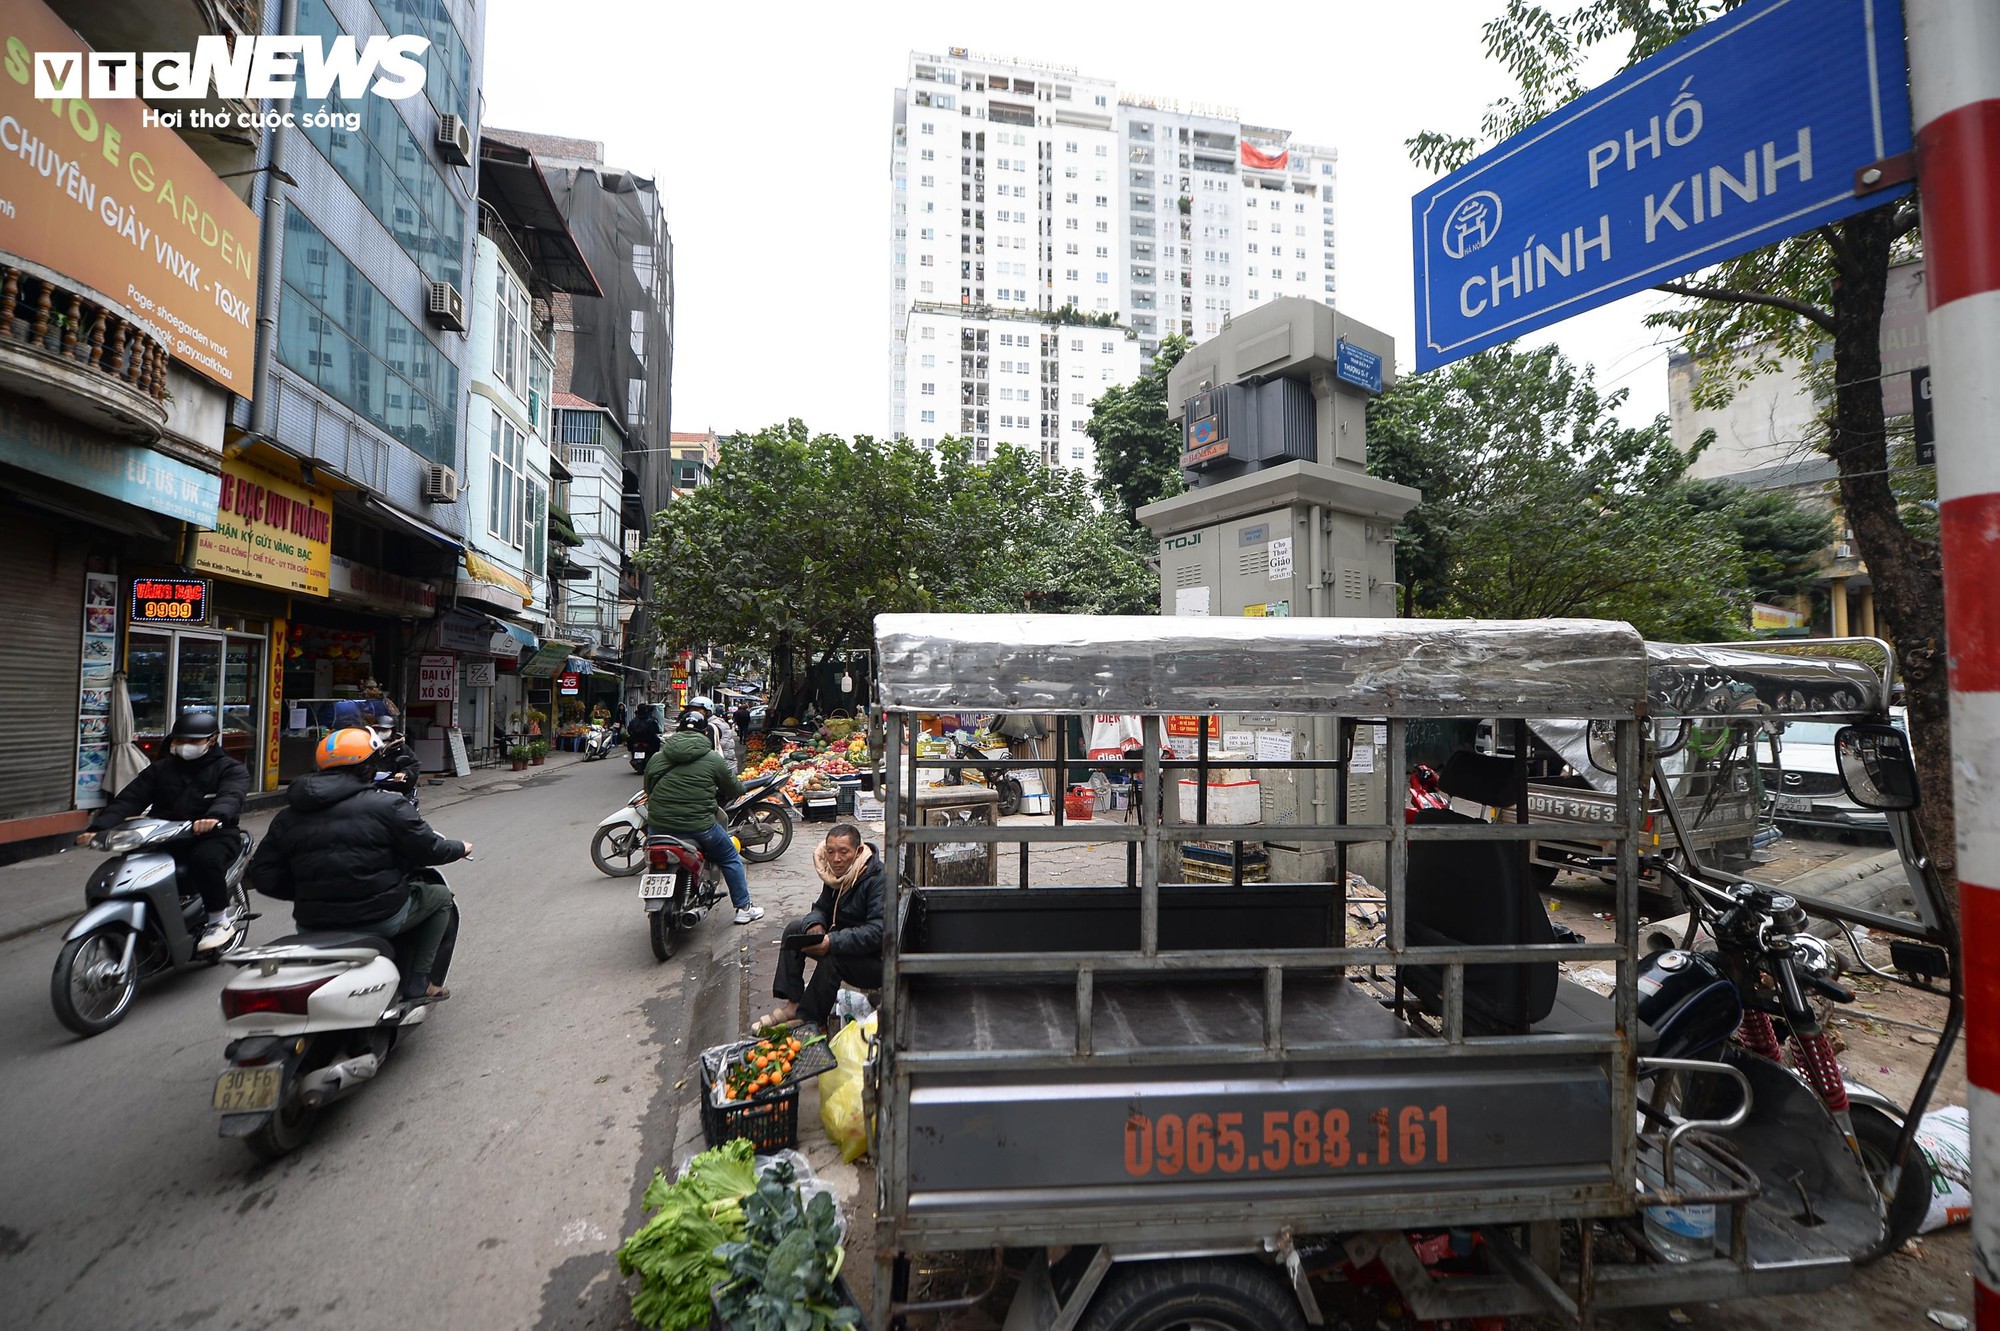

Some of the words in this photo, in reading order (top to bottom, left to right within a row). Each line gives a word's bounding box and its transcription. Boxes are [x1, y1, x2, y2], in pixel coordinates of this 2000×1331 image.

[1589, 75, 1704, 189] PHỐ
[0, 115, 96, 212] CHUYÊN
[100, 195, 150, 251] GIÀY
[155, 234, 201, 292] VNXK
[214, 280, 251, 329] TQXK
[129, 152, 252, 280] GARDEN
[1460, 214, 1611, 318] CHÍNH
[1645, 126, 1814, 244] KINH
[127, 284, 156, 313] Page:
[157, 306, 209, 346] shoegarden
[209, 339, 228, 359] vnxk
[235, 478, 265, 527] BẠC
[265, 489, 292, 532] DUY
[274, 537, 295, 556] VÀNG
[297, 547, 313, 561] BẠC
[1164, 533, 1202, 550] TOJI
[1269, 556, 1291, 568] Giáo
[136, 579, 172, 599] VÀNG
[174, 584, 202, 603] BẠC
[145, 602, 192, 618] 9999
[272, 632, 284, 699] VÀNG
[421, 669, 438, 683] ĐẠI
[440, 667, 451, 681] LÝ
[421, 682, 435, 698] XỔ
[437, 683, 450, 698] SỐ
[563, 679, 576, 687] 5G
[270, 712, 281, 763] BẠC
[1527, 796, 1565, 816] 0915
[644, 886, 669, 896] 9109
[225, 1069, 272, 1090] 30-F6
[1124, 1104, 1449, 1177] 0965.588.161
